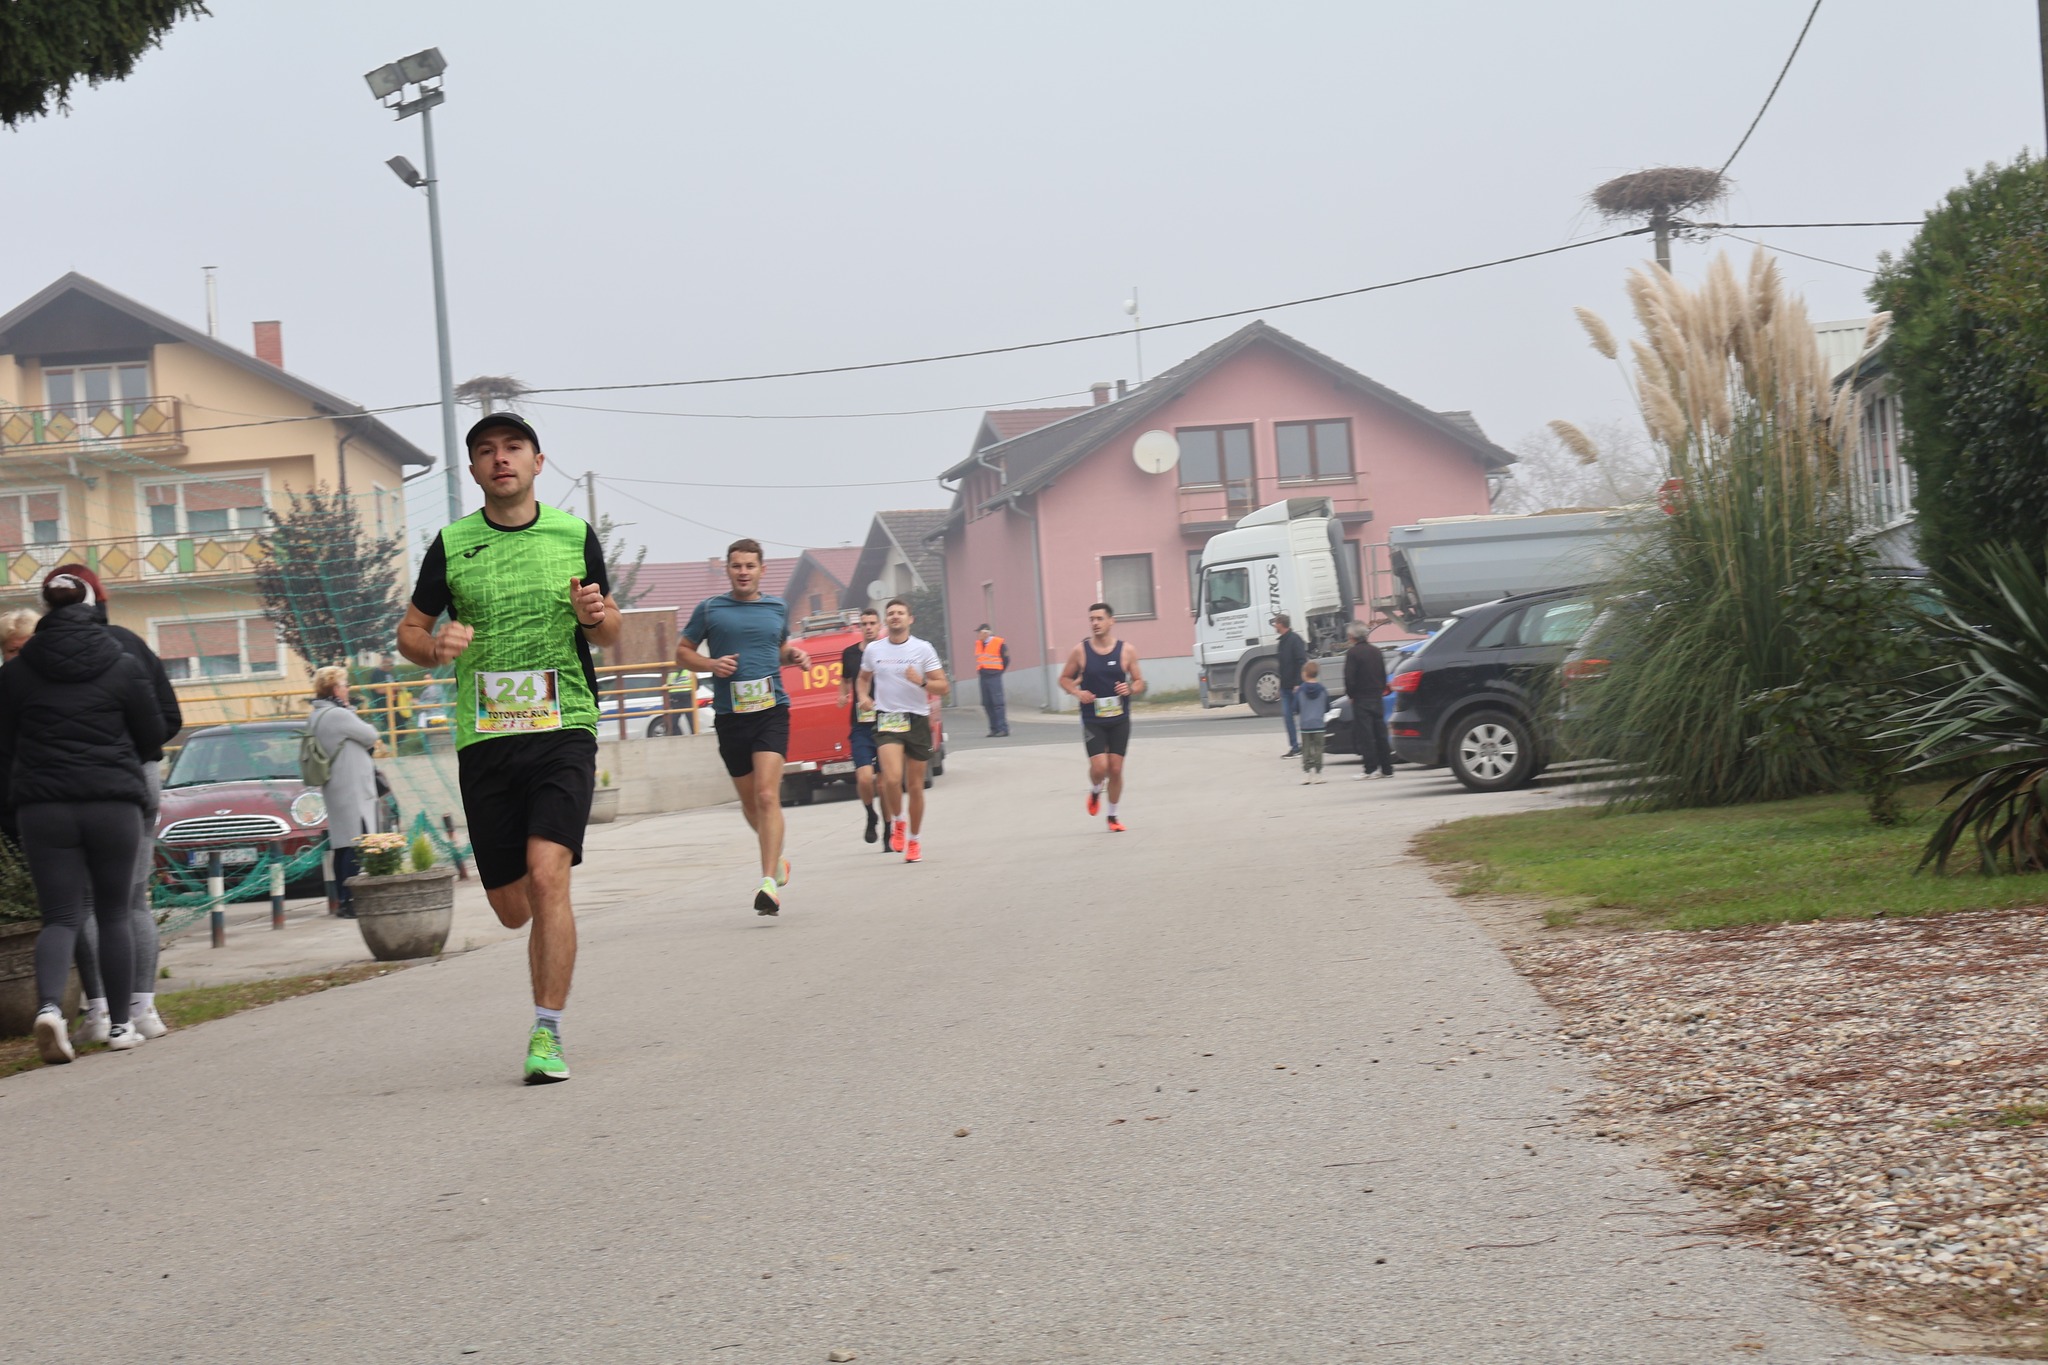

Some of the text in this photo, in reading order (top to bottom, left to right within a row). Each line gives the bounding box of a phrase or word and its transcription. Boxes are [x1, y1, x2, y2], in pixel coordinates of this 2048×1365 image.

[802, 662, 843, 689] 193
[496, 676, 537, 701] 24
[743, 682, 762, 698] 31
